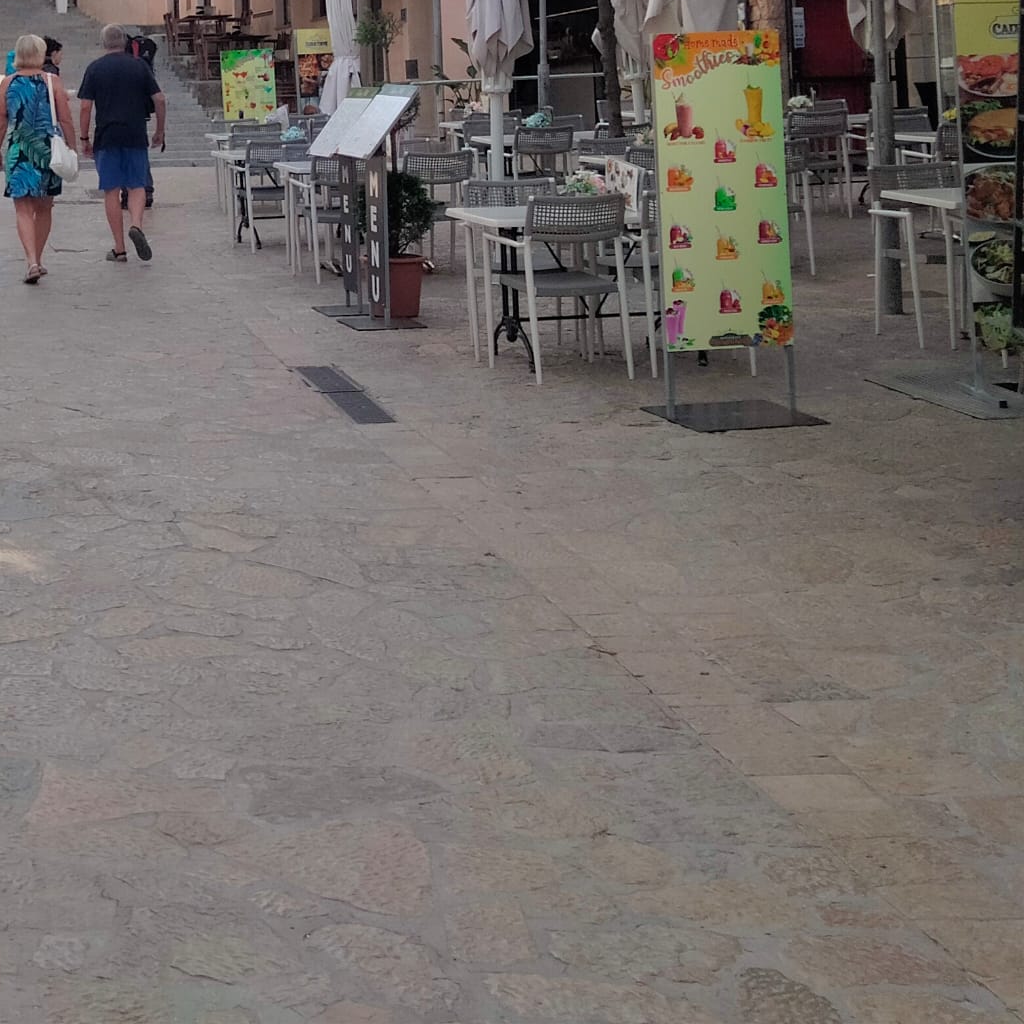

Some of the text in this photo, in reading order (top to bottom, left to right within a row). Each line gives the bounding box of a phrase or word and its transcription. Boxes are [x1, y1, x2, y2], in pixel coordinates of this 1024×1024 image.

[662, 50, 738, 90] Smoothies
[341, 165, 353, 273] MENU
[369, 170, 380, 303] MENU
